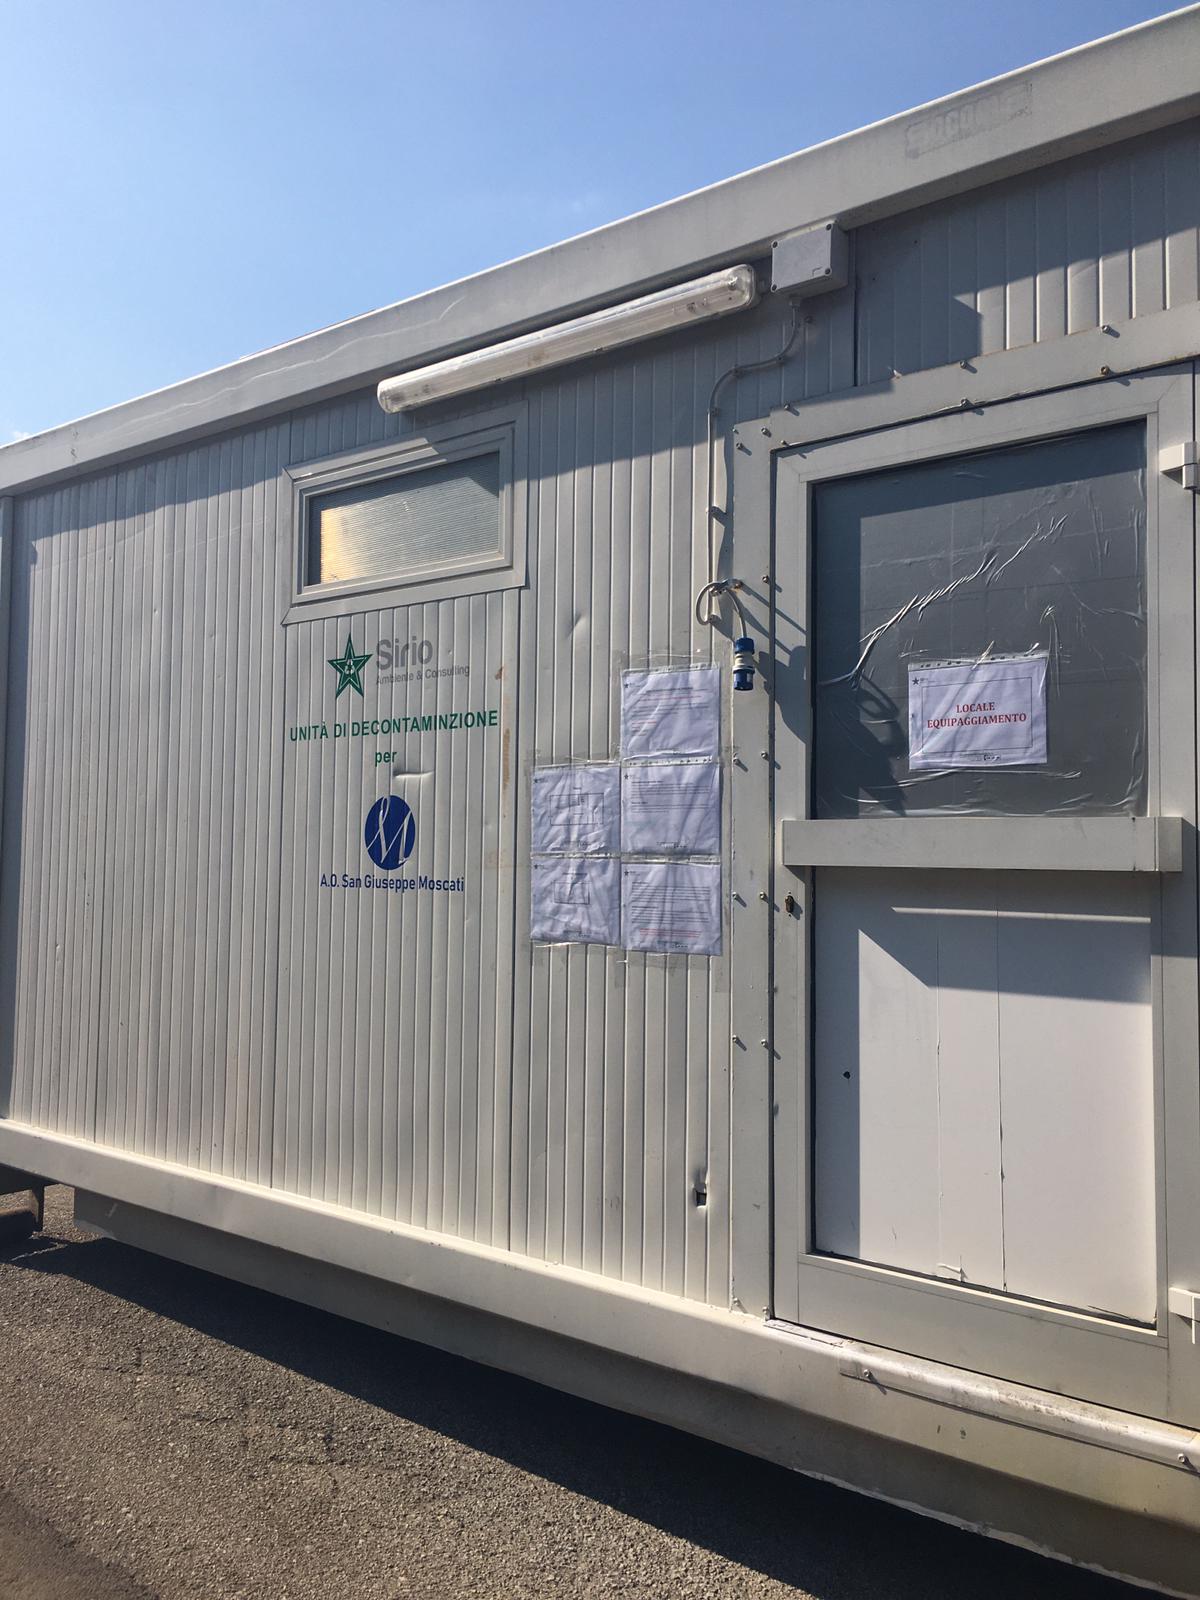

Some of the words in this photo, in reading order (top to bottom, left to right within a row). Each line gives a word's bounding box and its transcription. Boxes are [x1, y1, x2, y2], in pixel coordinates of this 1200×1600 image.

[376, 636, 433, 670] Sirio
[376, 671, 414, 685] Ambiente
[416, 670, 423, 681] &
[425, 665, 470, 680] Consulting
[956, 702, 996, 713] LOCALE
[290, 721, 329, 741] UNITÀ
[334, 723, 346, 738] DI
[351, 710, 498, 736] DECONTAMINZIONE
[927, 713, 1027, 729] EQUIPAGGIAMENTO
[375, 751, 397, 767] per
[320, 874, 339, 888] A.O.
[342, 874, 362, 888] San
[364, 875, 416, 893] Giuseppe
[418, 876, 465, 892] Moscati
